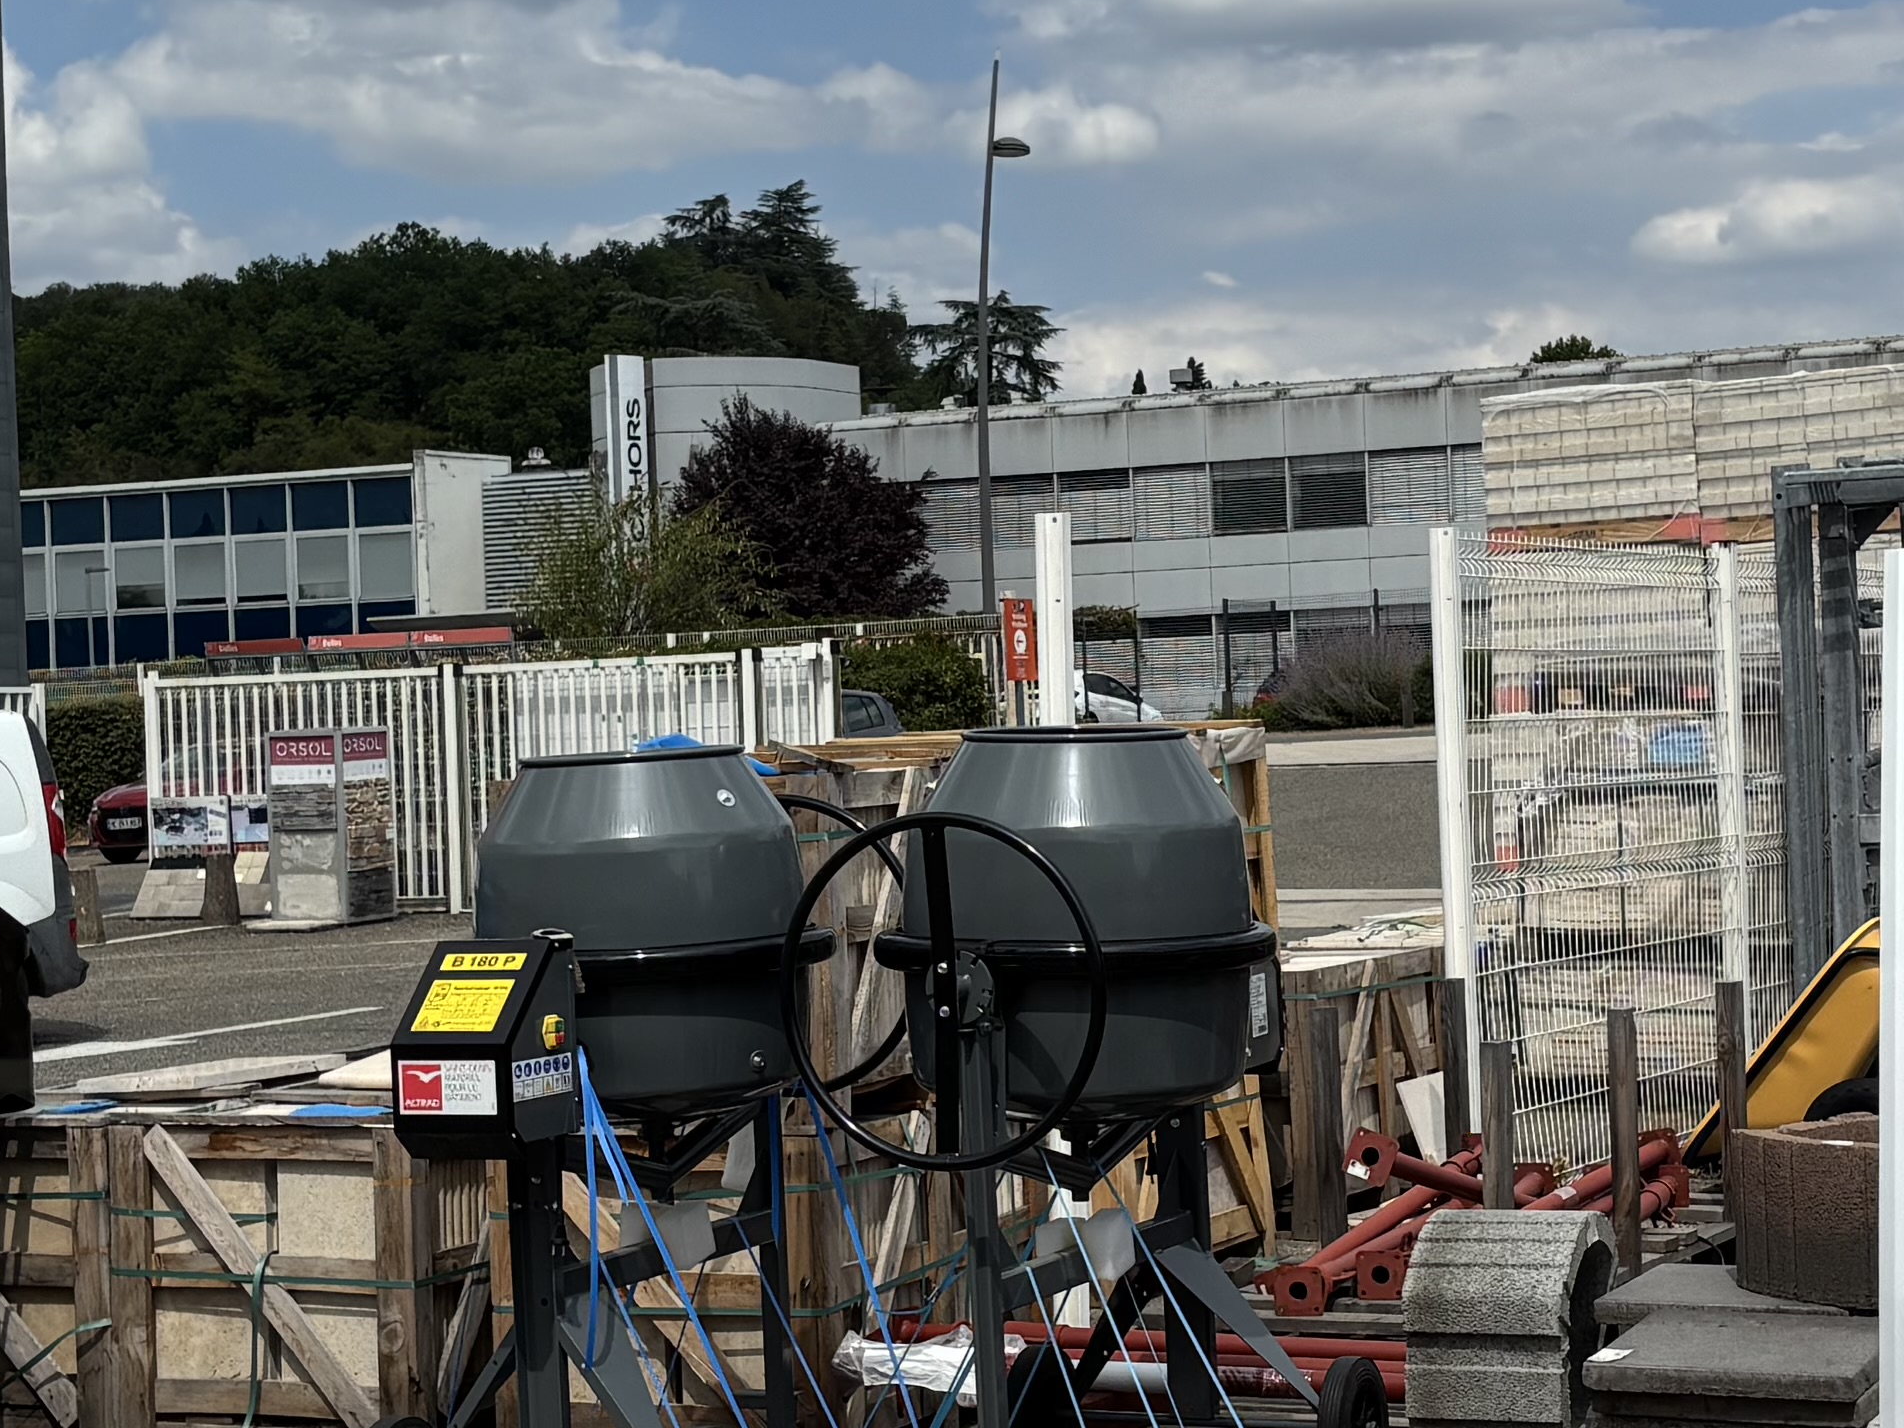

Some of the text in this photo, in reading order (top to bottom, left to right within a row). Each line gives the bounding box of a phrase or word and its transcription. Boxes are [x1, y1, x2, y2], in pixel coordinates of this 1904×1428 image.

[626, 398, 645, 542] CHORS
[276, 742, 332, 756] ORSOL
[343, 736, 383, 753] ORSOL
[451, 956, 516, 967] B 180 P
